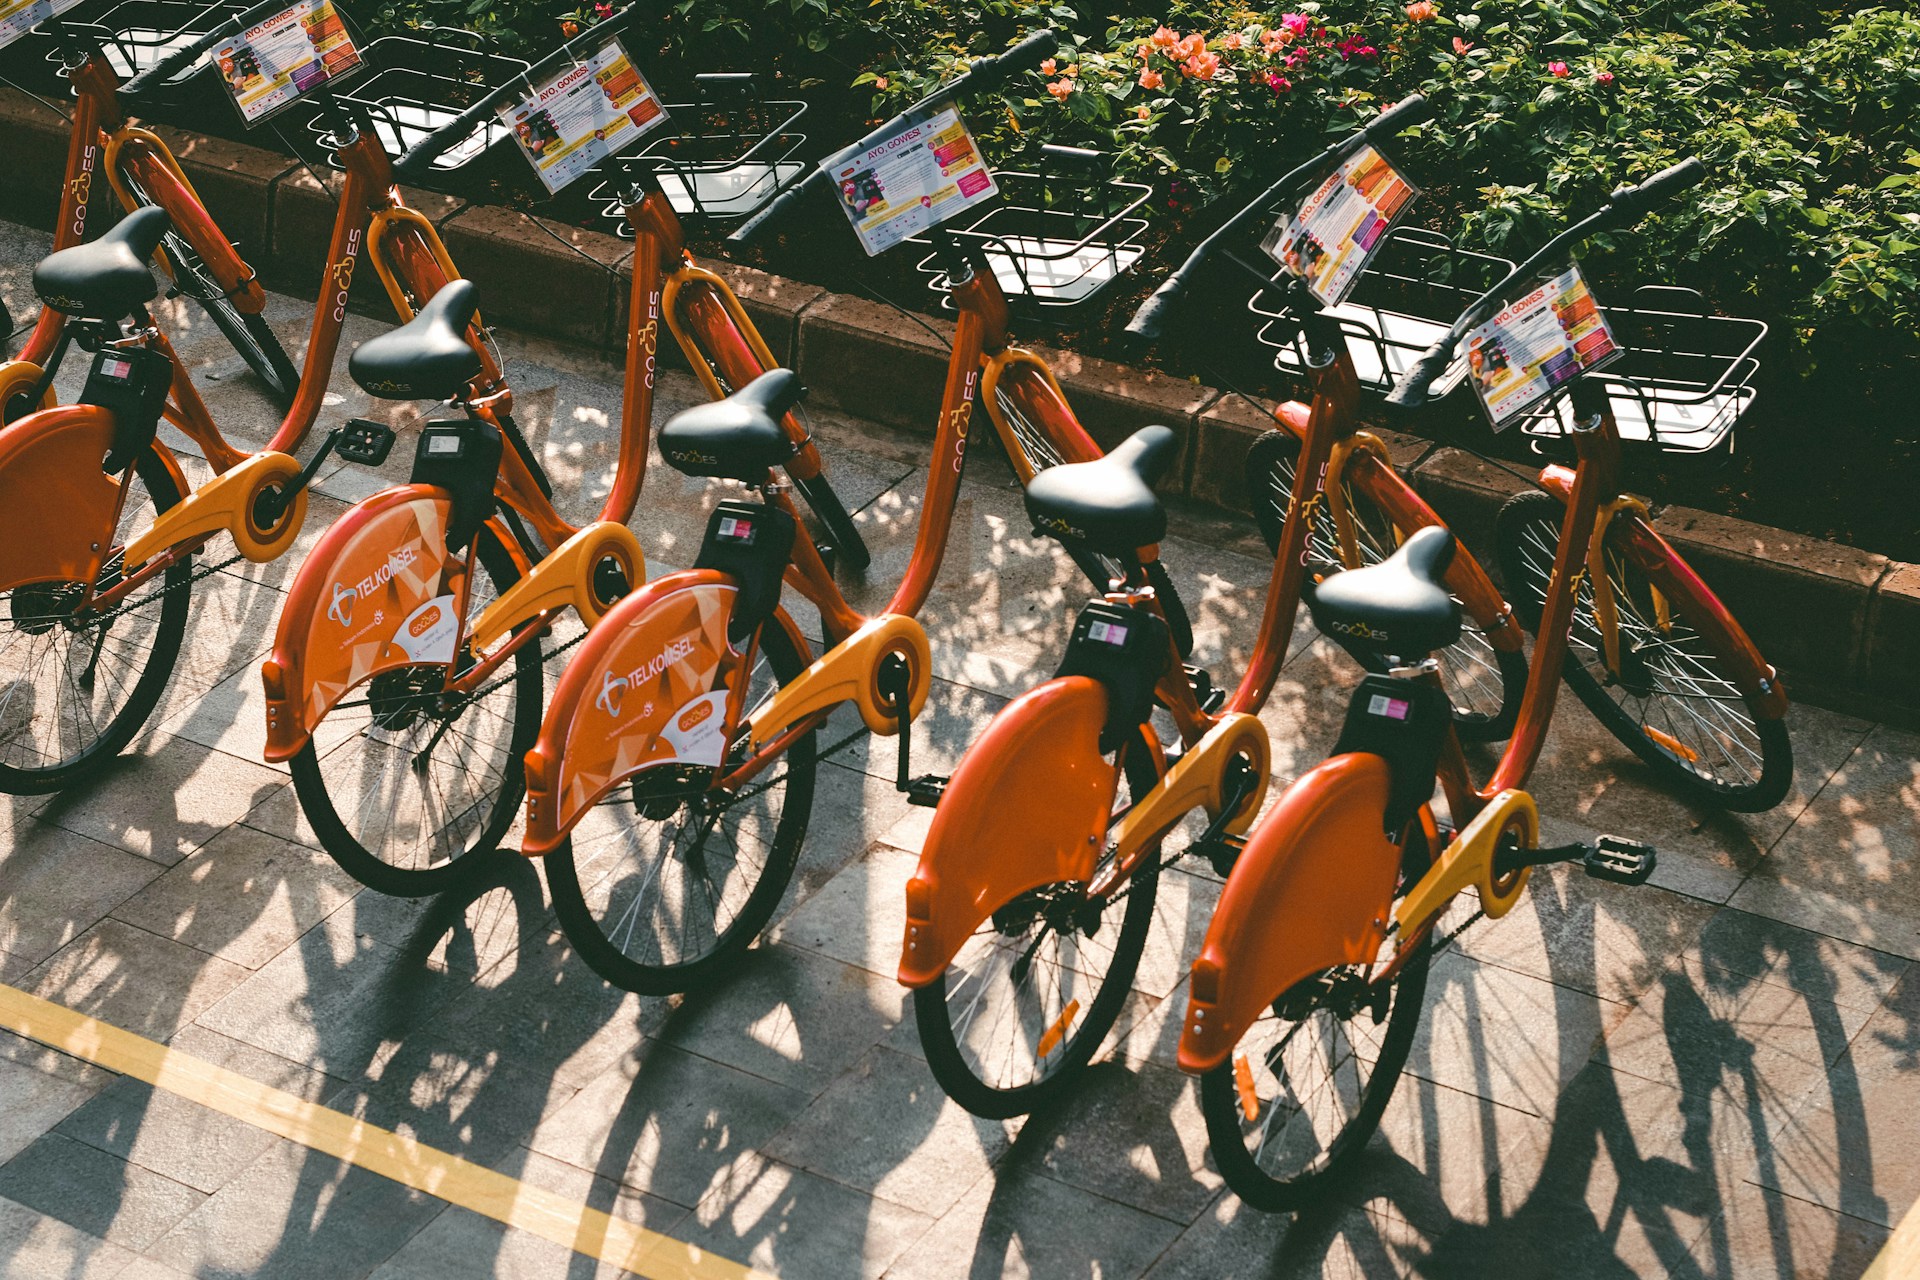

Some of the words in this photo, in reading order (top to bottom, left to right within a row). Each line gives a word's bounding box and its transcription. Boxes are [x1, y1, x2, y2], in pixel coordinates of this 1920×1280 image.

[244, 26, 263, 40] AYO,
[262, 8, 295, 29] GOWES!
[539, 86, 558, 102] AYO,
[557, 65, 589, 89] GOWES!
[868, 146, 888, 161] AYO,
[887, 128, 921, 149] GOWES!
[1299, 205, 1315, 224] AYO,
[1313, 172, 1340, 204] GOWES!
[1493, 310, 1512, 327] AYO,
[1511, 290, 1545, 314] GOWES!
[356, 546, 418, 599] TELKOMSEL
[628, 636, 695, 690] TELKOMSEL
